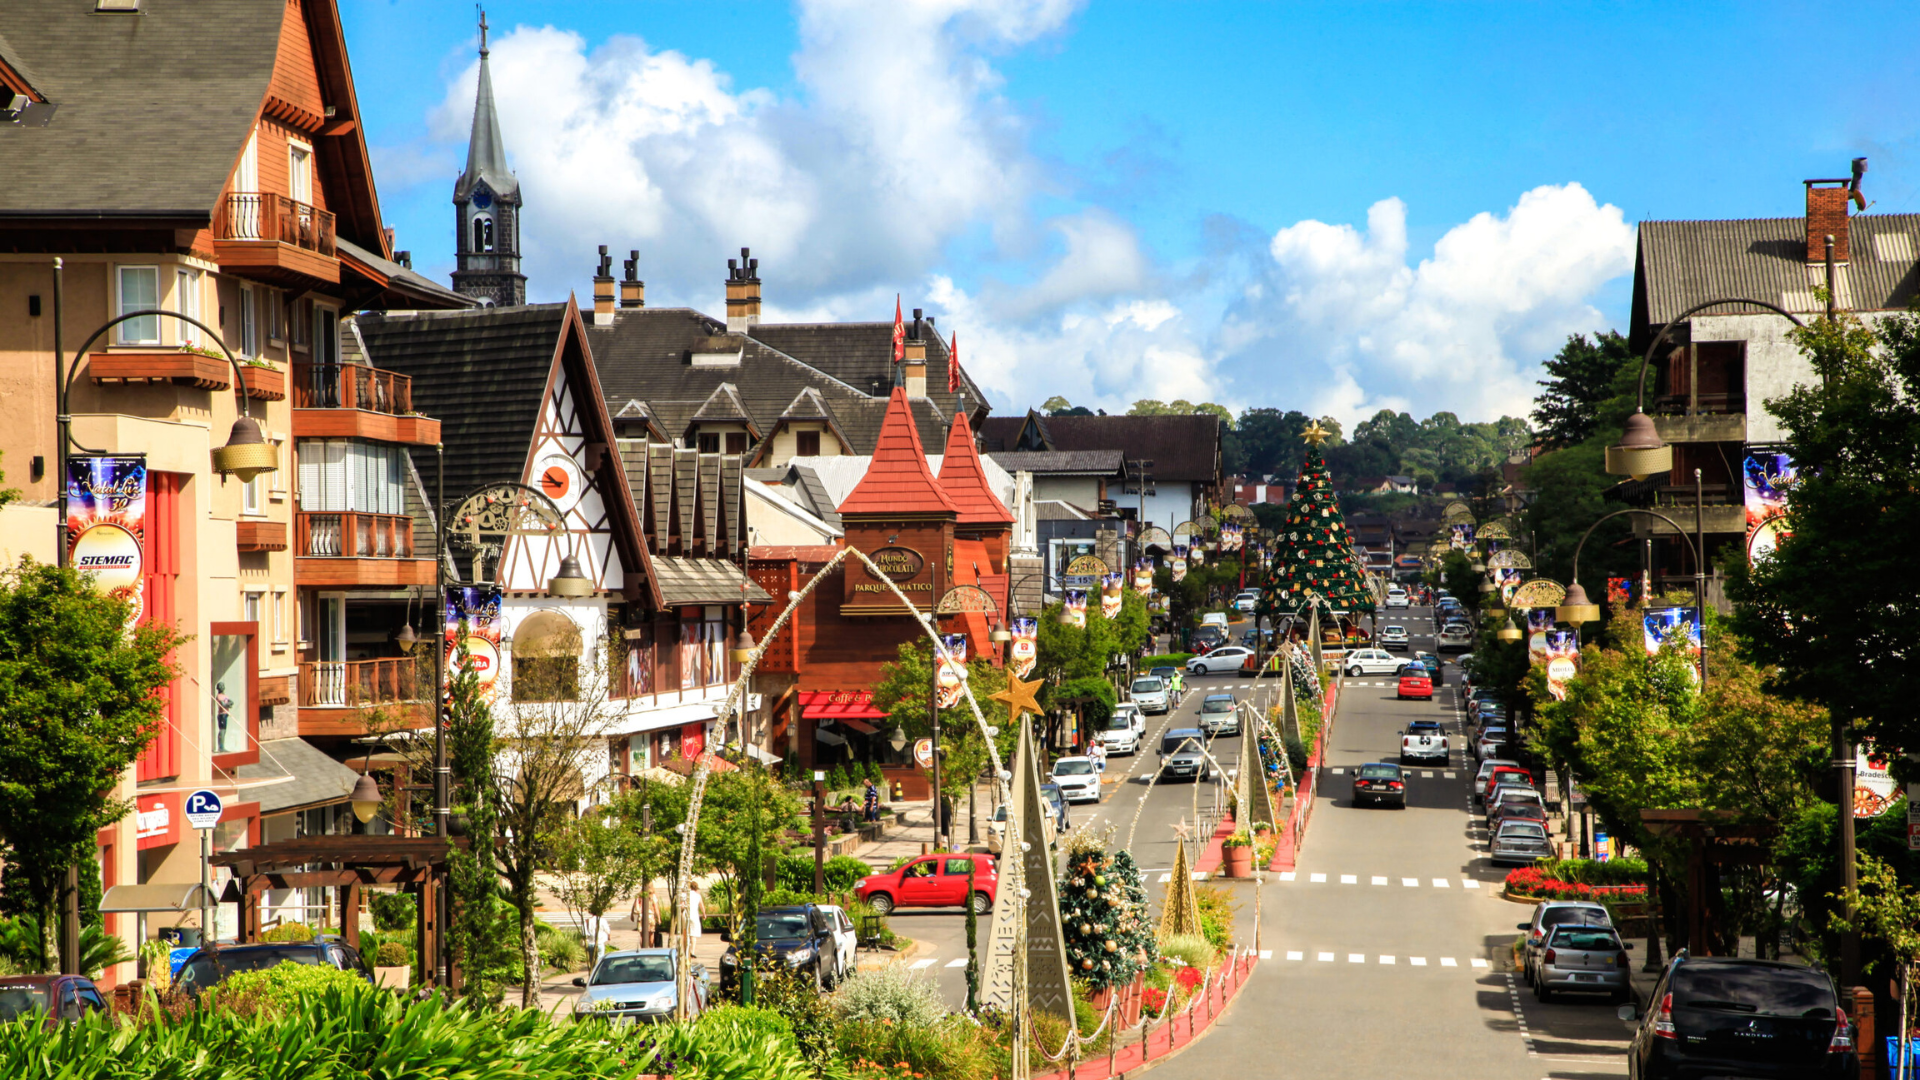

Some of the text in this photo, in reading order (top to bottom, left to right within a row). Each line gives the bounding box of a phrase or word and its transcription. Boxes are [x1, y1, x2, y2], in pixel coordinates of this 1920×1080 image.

[76, 473, 142, 499] Natal Luz
[80, 555, 134, 565] STEMAC
[855, 582, 932, 593] PARQUE MÁTICO
[193, 796, 206, 812] P
